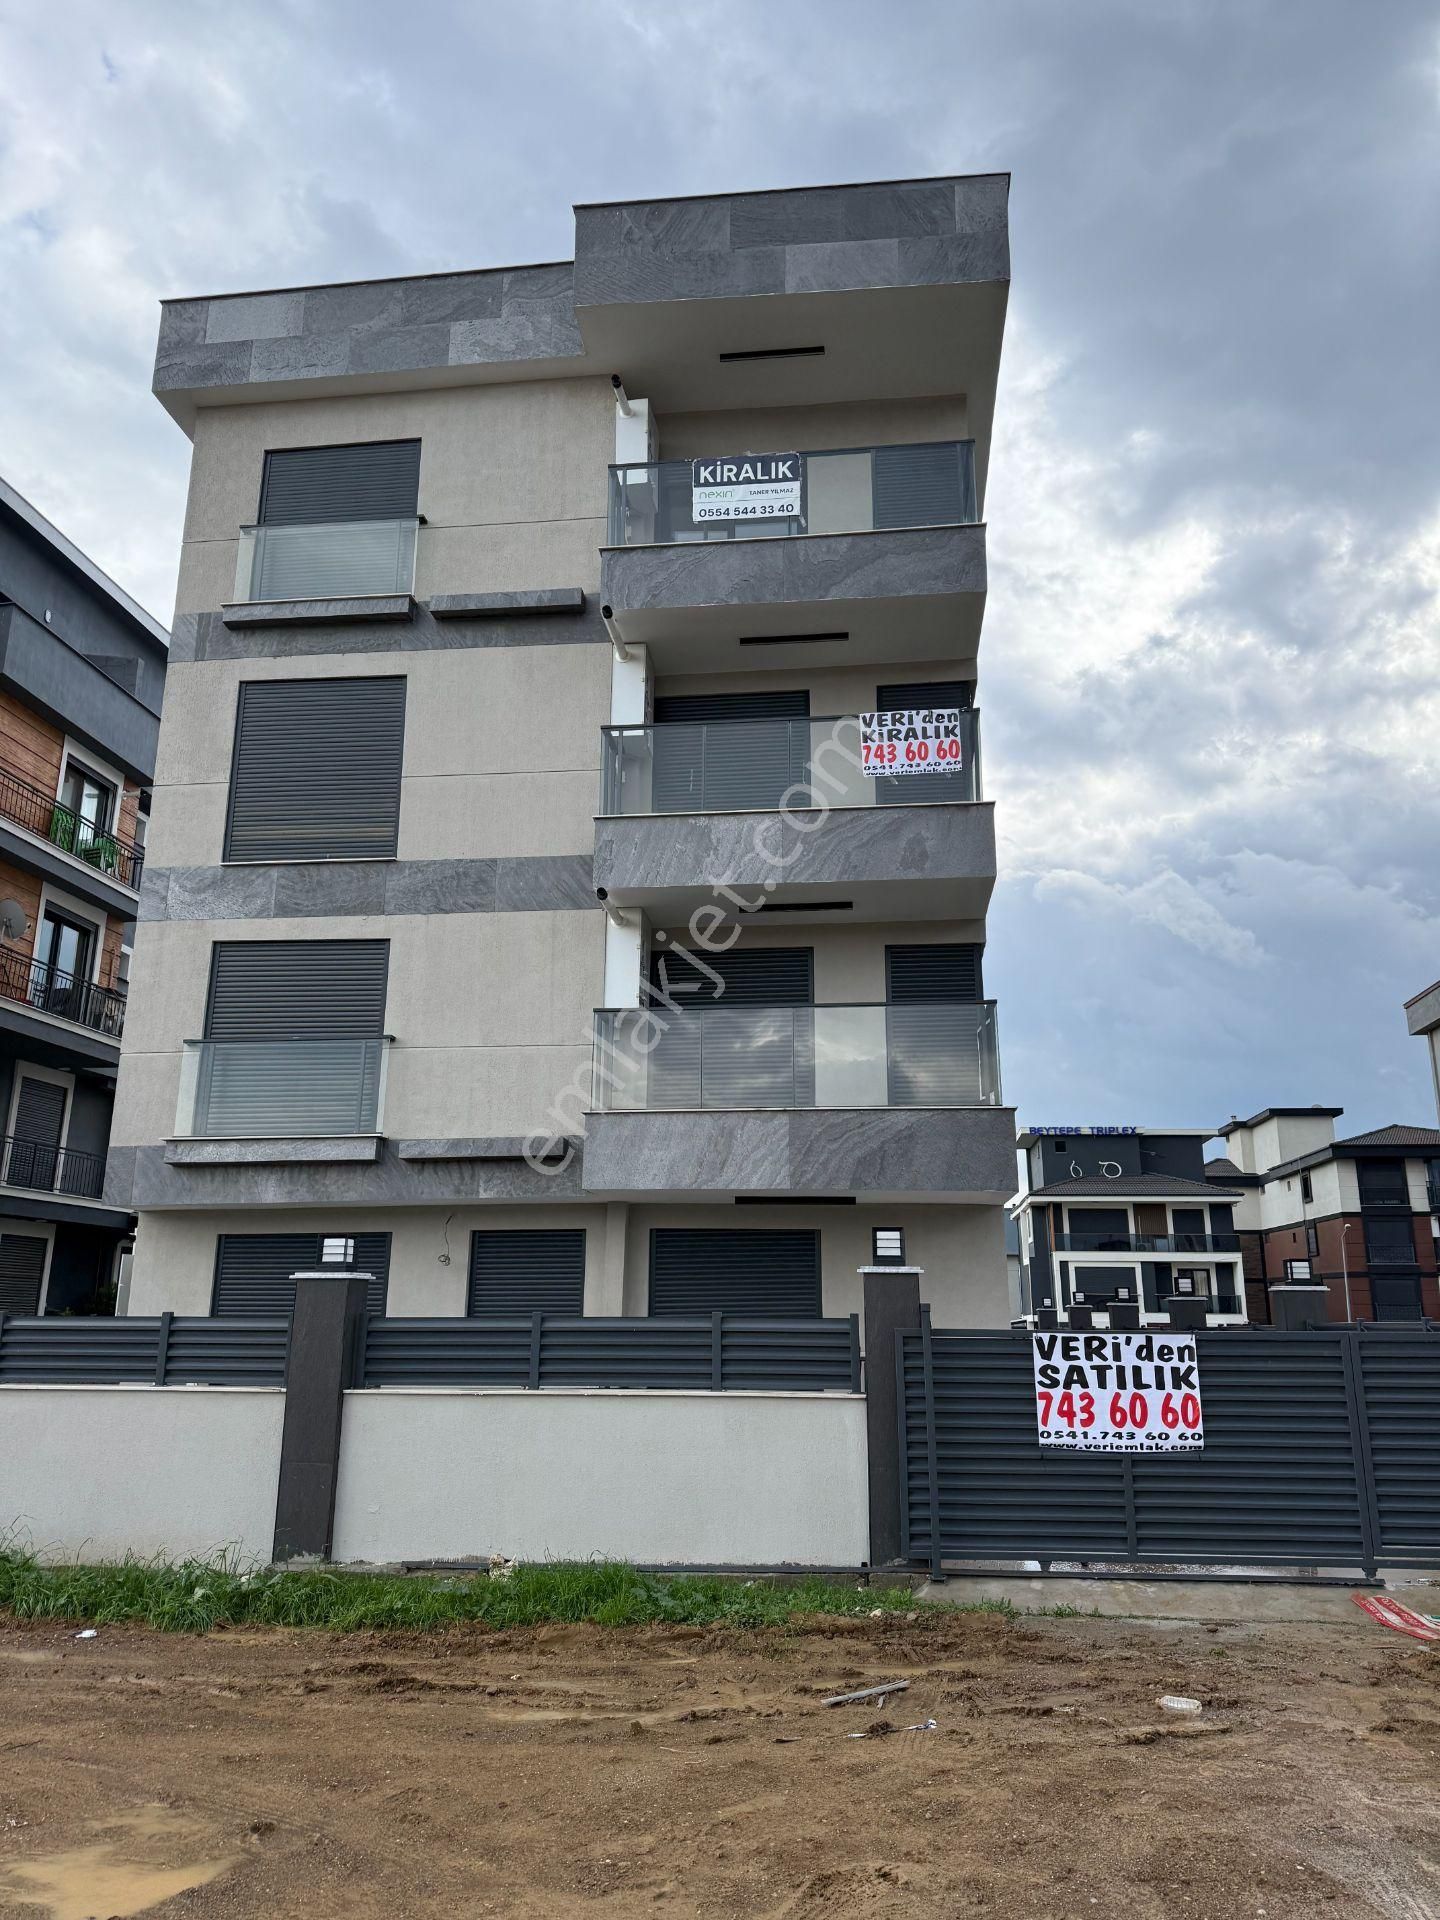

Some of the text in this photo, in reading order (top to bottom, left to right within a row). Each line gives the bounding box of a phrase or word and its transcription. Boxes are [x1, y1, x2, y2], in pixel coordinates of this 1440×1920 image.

[699, 460, 793, 484] KİRALIK
[699, 503, 794, 518] 0554 544 33 40
[862, 739, 961, 764] 743 60 60
[1029, 1126, 1137, 1136] BEYTEPE TRIPLEX
[1037, 1364, 1197, 1390] SATILIK
[1038, 1391, 1201, 1430] 743 60 60
[1039, 1430, 1203, 1441] 0541.743 60 60
[1040, 1442, 1203, 1451] www.veriemlak.com
